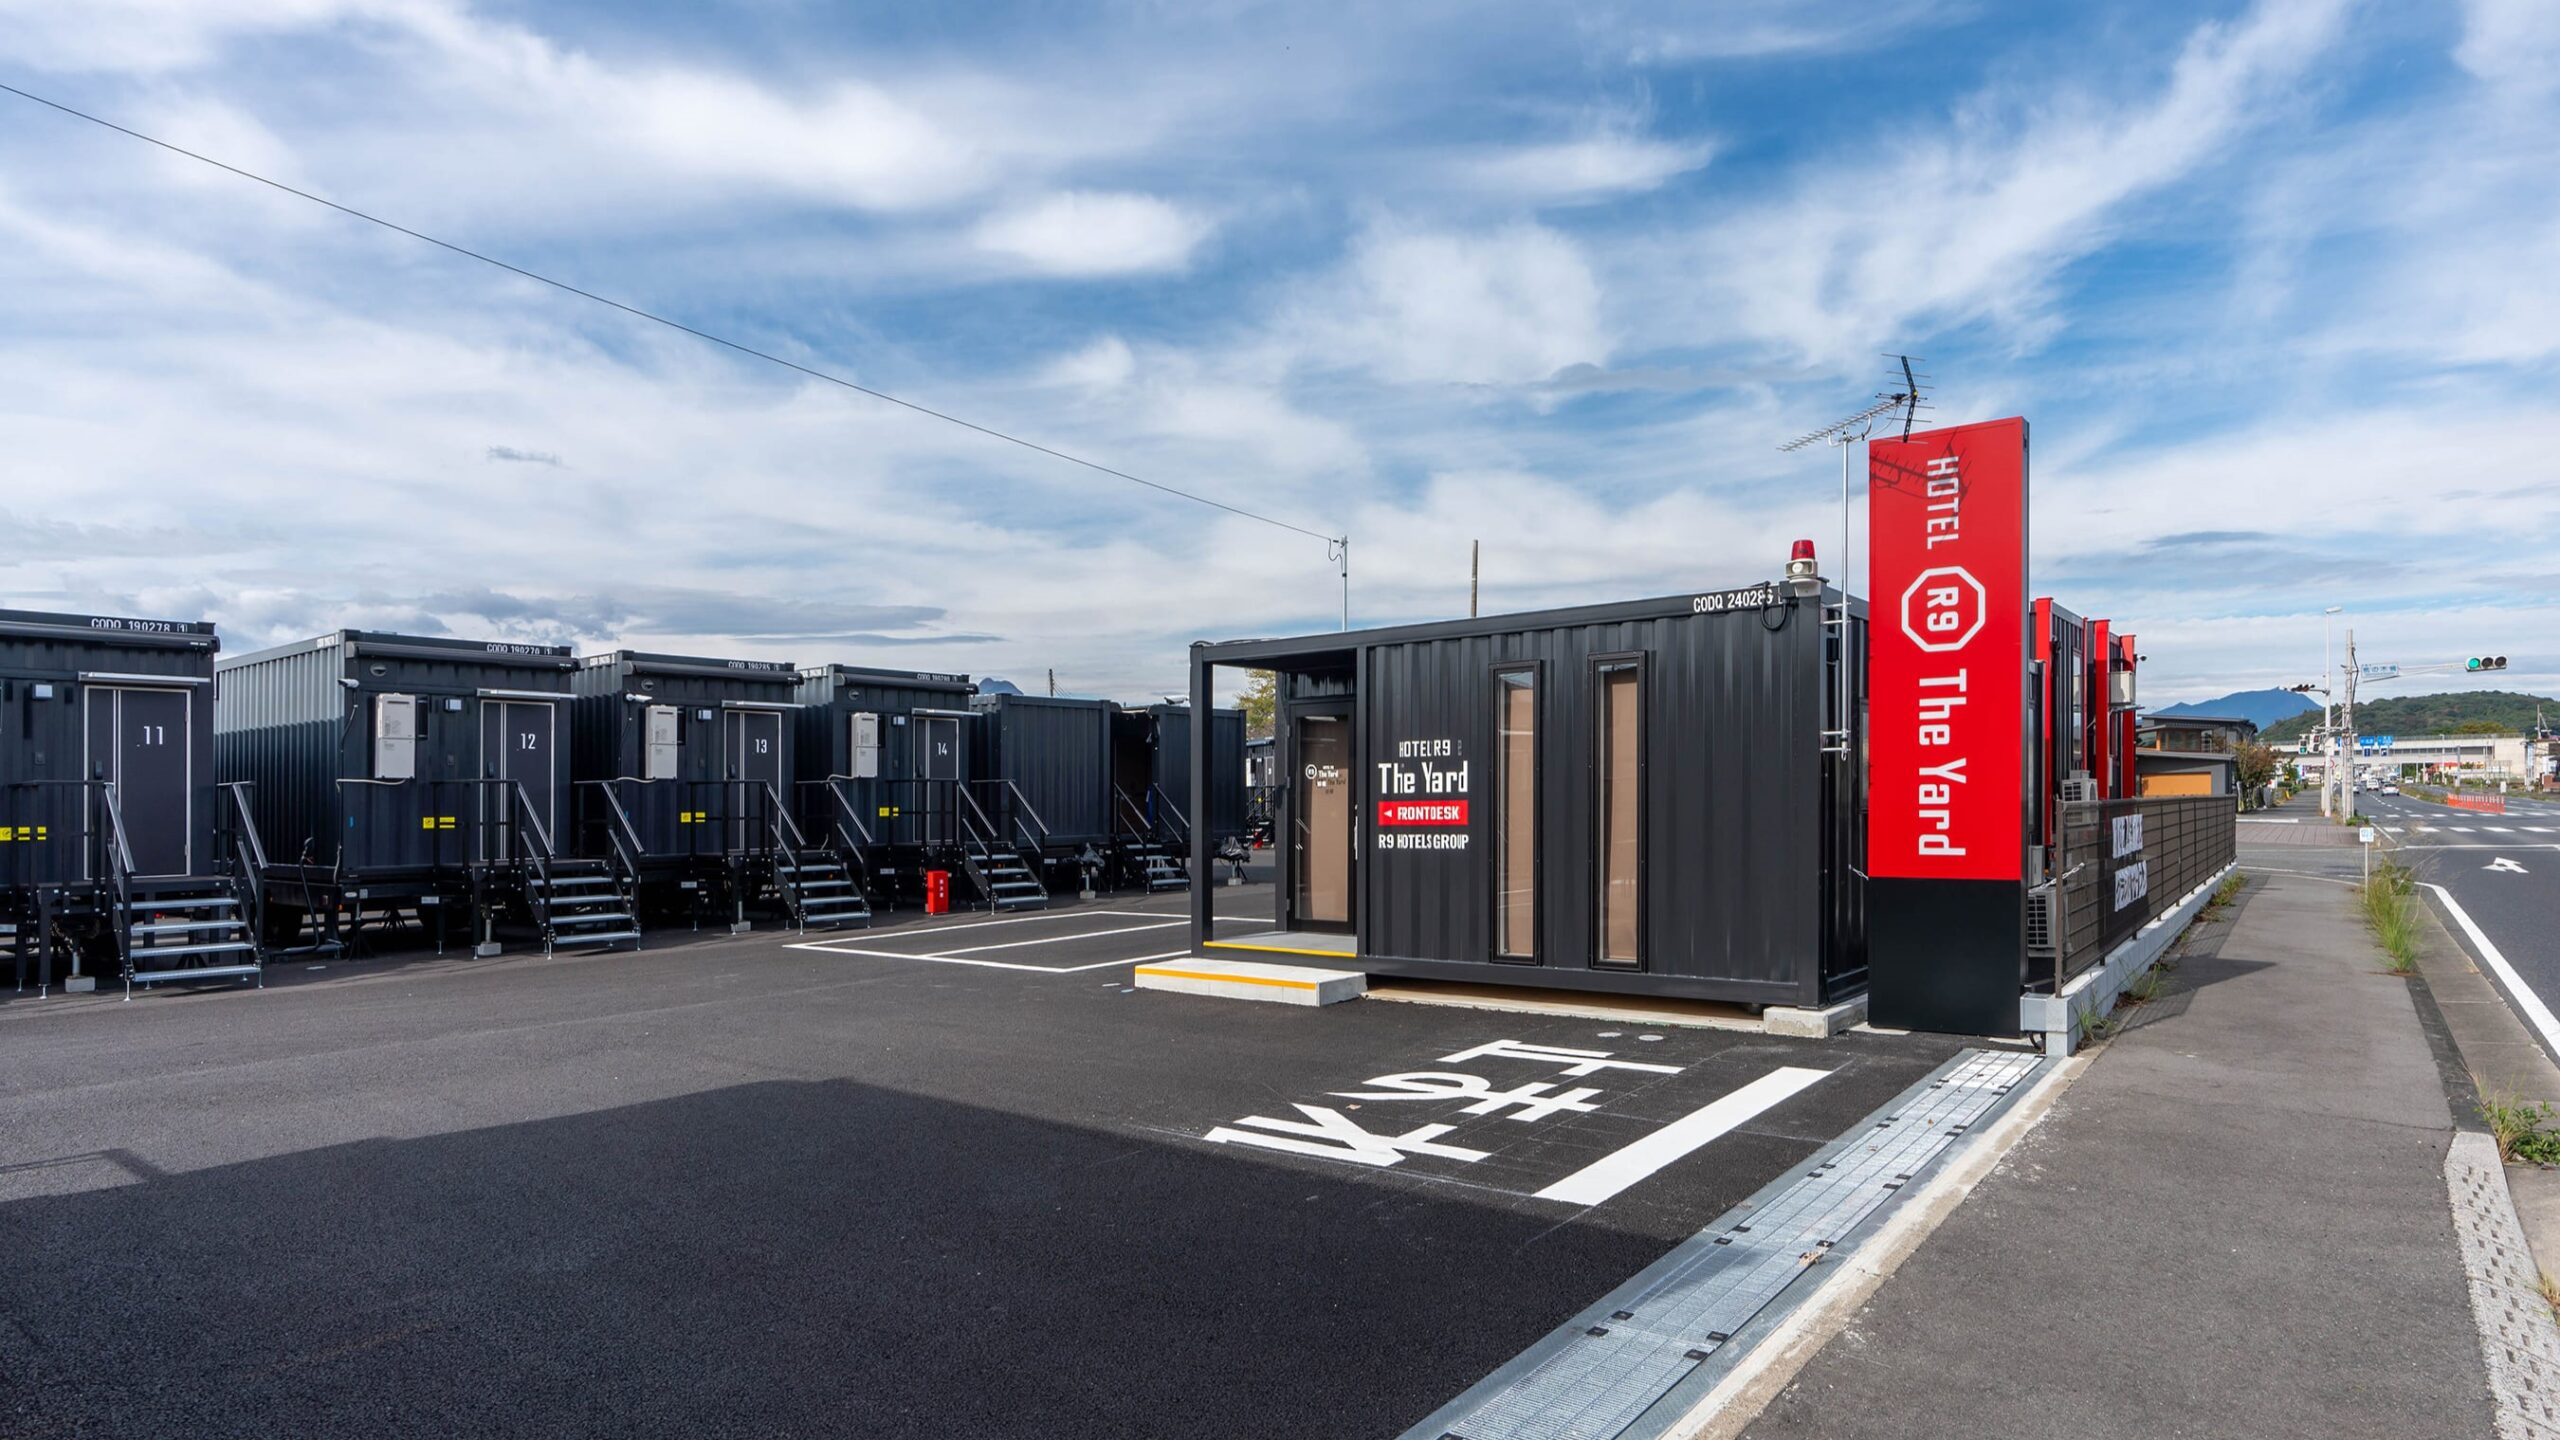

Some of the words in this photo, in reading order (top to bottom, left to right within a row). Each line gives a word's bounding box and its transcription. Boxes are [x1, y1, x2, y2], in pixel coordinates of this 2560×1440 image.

[1926, 456, 1959, 550] HOTEL
[1926, 586, 1960, 632] R9
[1918, 668, 1968, 746] The
[143, 726, 164, 745] 11
[520, 733, 536, 750] 12
[755, 738, 768, 754] 13
[1398, 740, 1432, 758] HOTEL
[1434, 739, 1451, 756] R9
[937, 742, 948, 756] 14
[1378, 762, 1416, 794] The
[1422, 760, 1469, 794] Yard
[1918, 757, 1968, 856] Yard
[1378, 834, 1394, 850] R9
[1203, 1039, 1686, 1167] 止まれ
